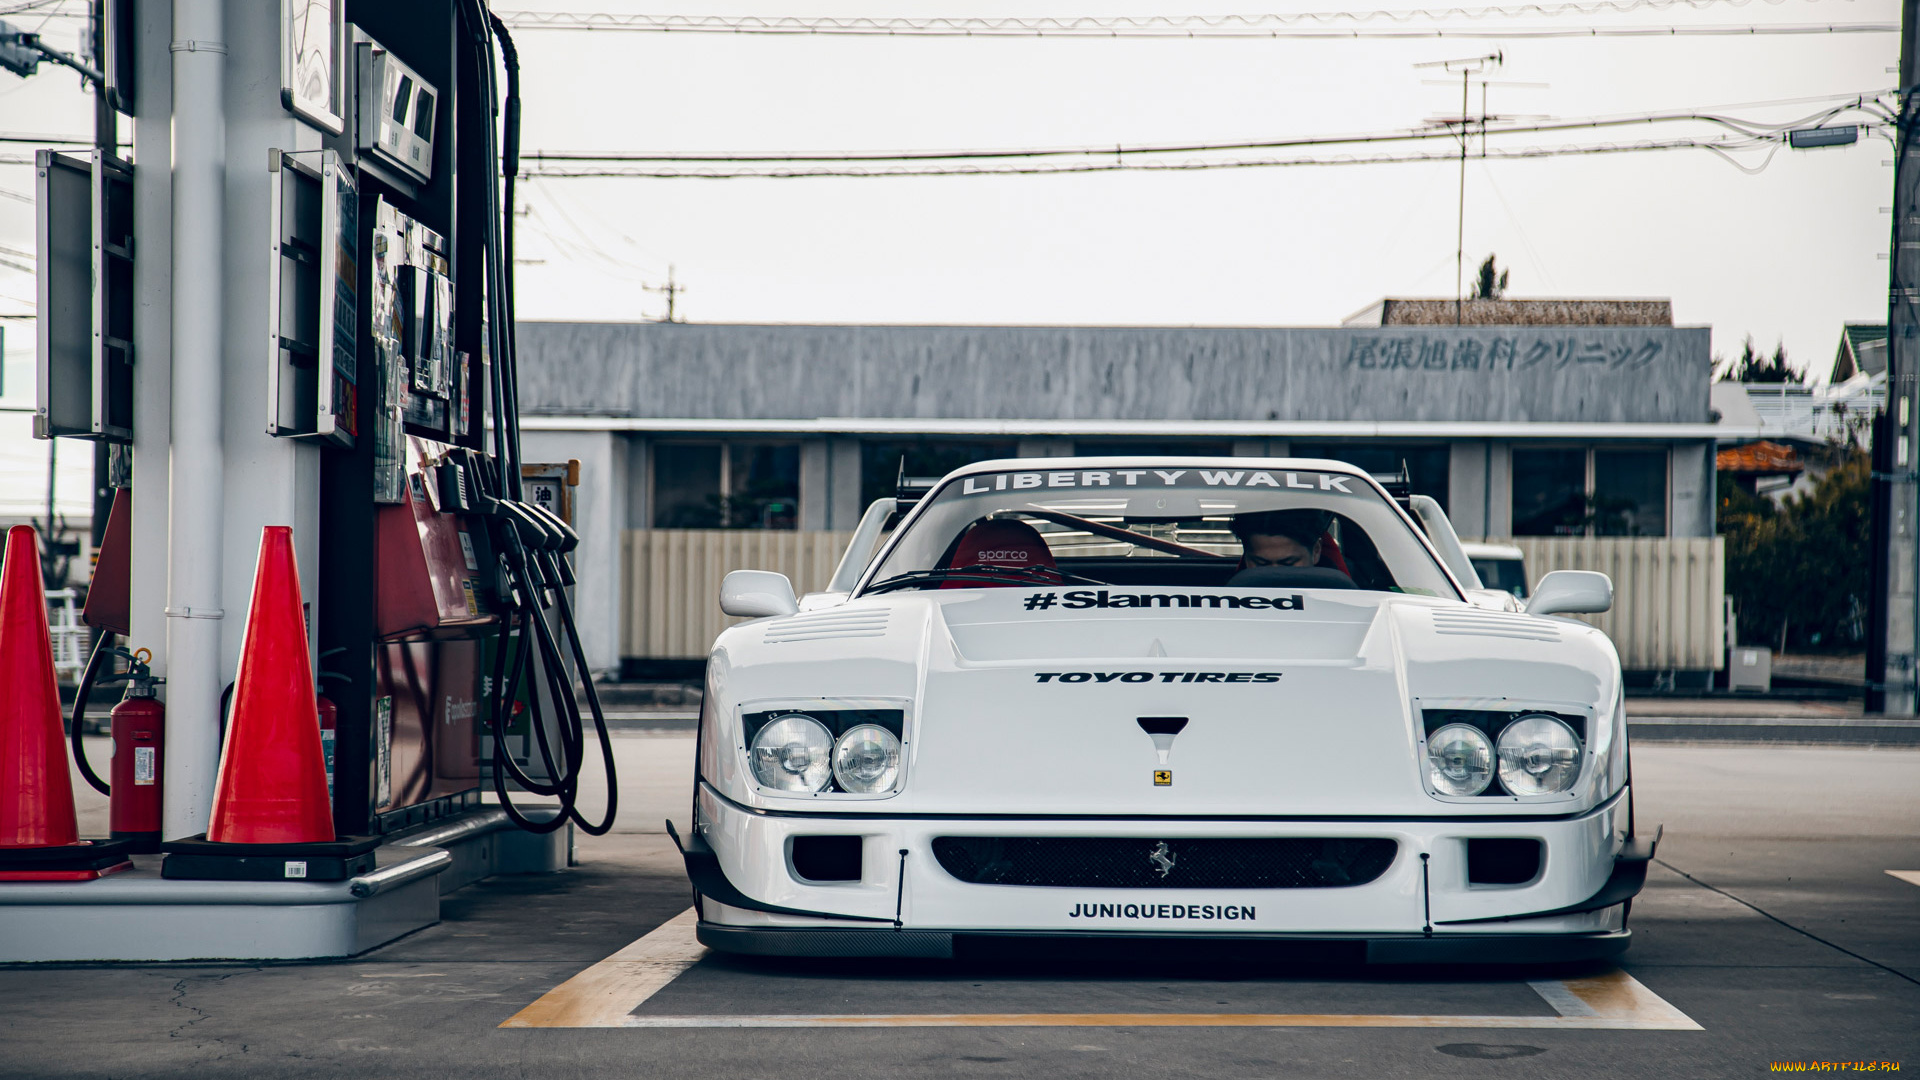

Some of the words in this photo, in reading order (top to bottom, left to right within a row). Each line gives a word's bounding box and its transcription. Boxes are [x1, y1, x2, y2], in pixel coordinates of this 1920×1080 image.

[1344, 336, 1663, 372] 尾張旭歯科クリニック
[963, 470, 1187, 495] LIBERTY
[1199, 470, 1353, 494] WALK
[978, 550, 1028, 561] sparco
[1023, 590, 1305, 611] #Slammed
[1034, 672, 1154, 683] TOYO
[1159, 672, 1283, 683] TIRES
[1069, 903, 1256, 920] JUNIQUEDESIGN
